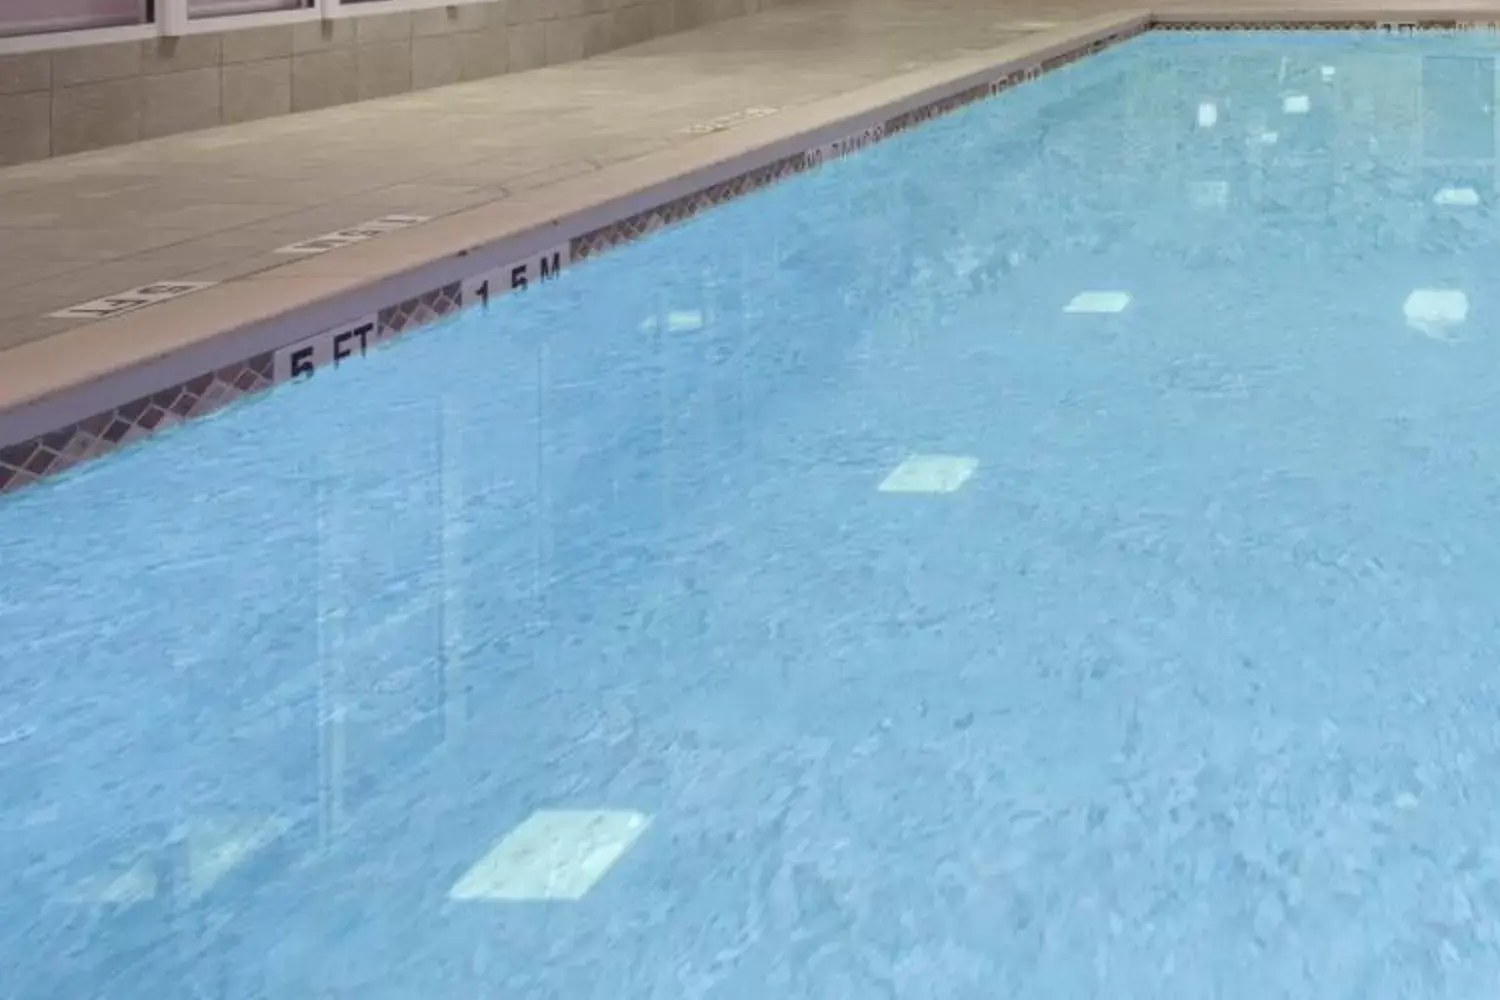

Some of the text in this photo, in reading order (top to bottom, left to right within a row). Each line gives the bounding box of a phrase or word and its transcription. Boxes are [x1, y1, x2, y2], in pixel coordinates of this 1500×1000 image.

[540, 252, 561, 283] M
[290, 323, 374, 382] 5 FT
